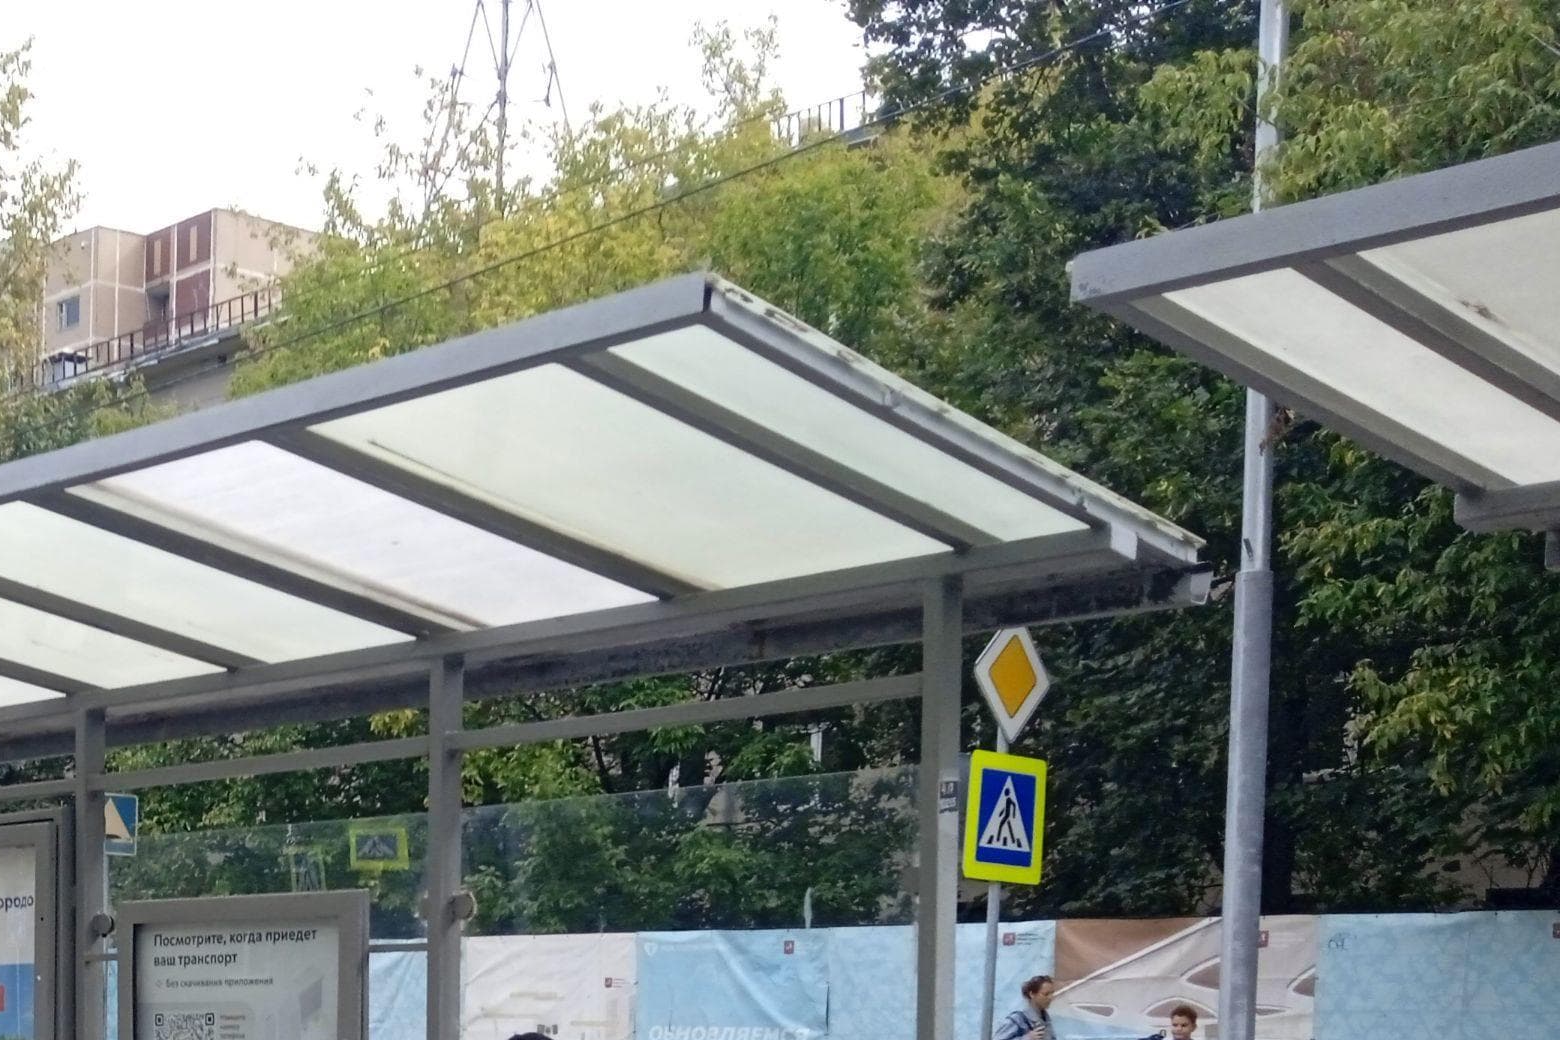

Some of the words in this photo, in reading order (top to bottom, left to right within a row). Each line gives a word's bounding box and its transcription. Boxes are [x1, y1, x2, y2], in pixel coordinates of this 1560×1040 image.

[153, 933, 227, 948] Посмотрите,
[229, 931, 263, 945] когда
[265, 929, 318, 944] приедет
[153, 955, 177, 967] ваш
[178, 952, 238, 968] транспорт
